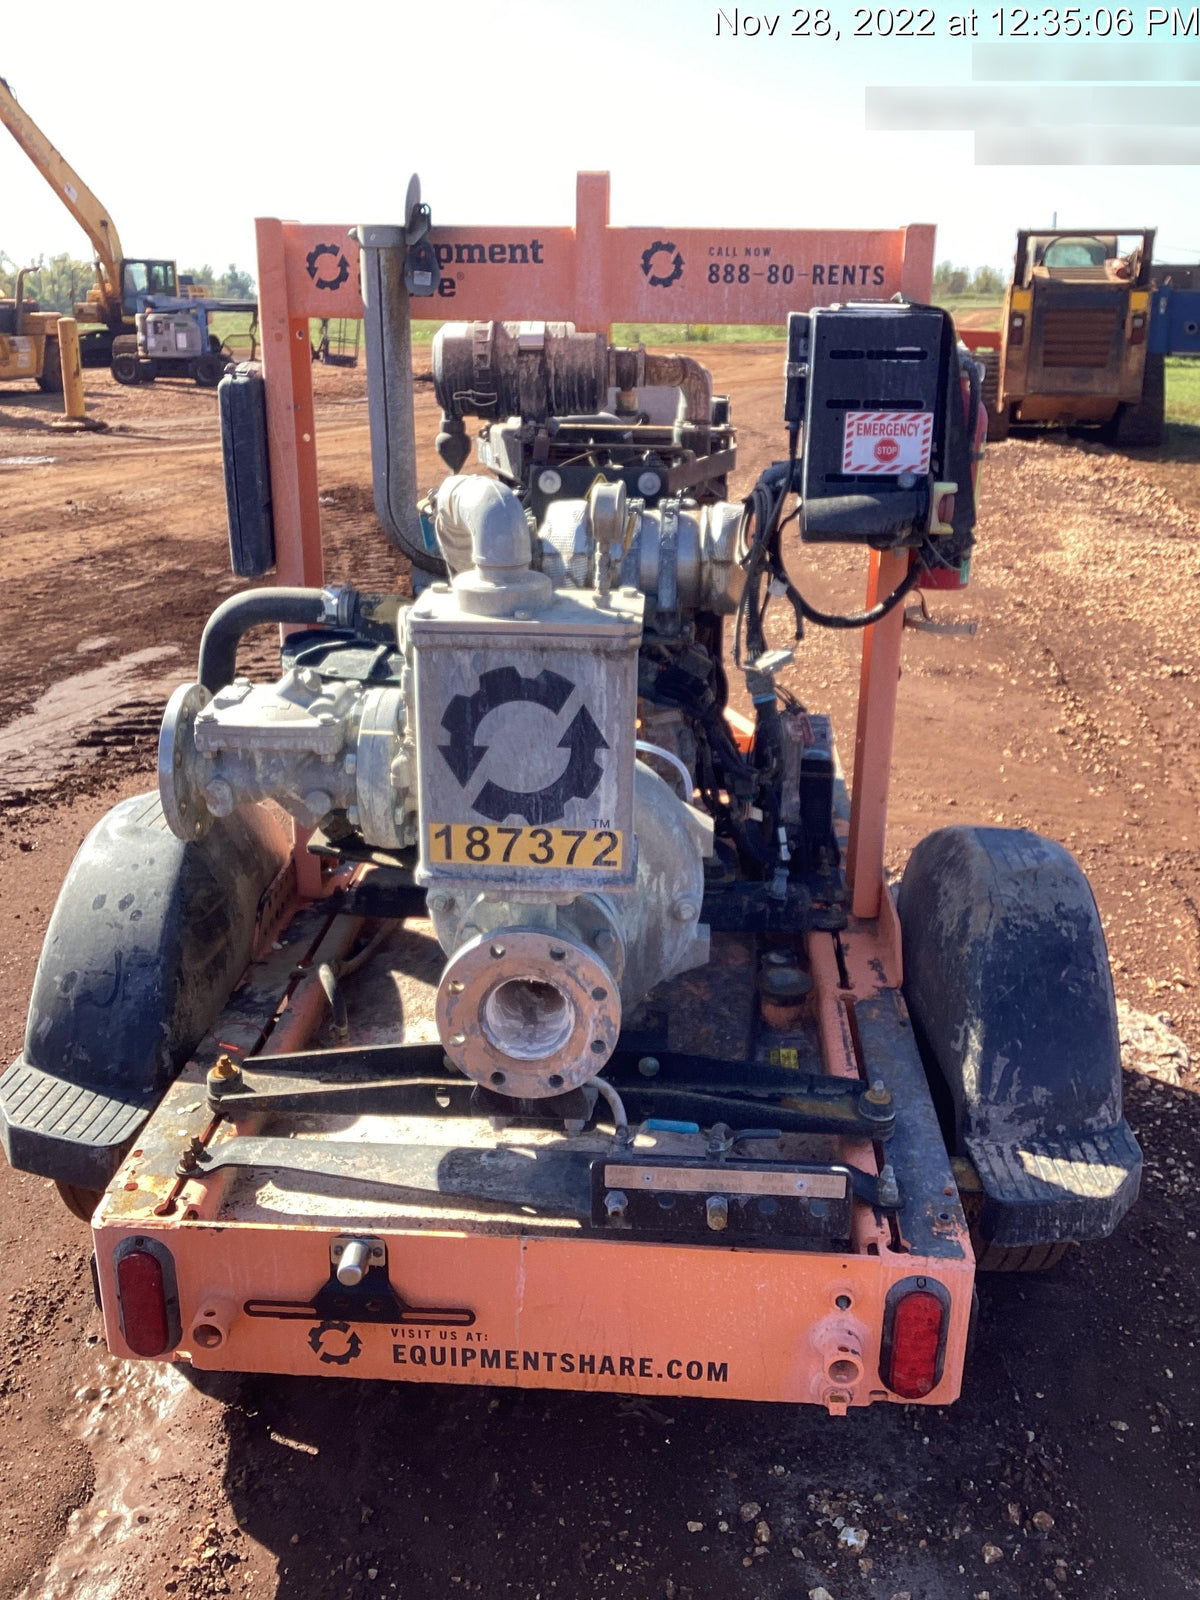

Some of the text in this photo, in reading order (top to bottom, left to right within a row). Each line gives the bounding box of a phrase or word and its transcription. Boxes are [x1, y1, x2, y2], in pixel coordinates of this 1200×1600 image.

[708, 247, 772, 257] CALL NOW
[707, 263, 885, 286] 888-80-RENTS
[856, 422, 920, 437] EMERGENCY
[877, 446, 898, 455] STOP
[434, 824, 619, 868] 187372
[390, 1328, 489, 1342] VISIT US AT:
[392, 1344, 728, 1383] EQUIPMENTSHARE.COM
